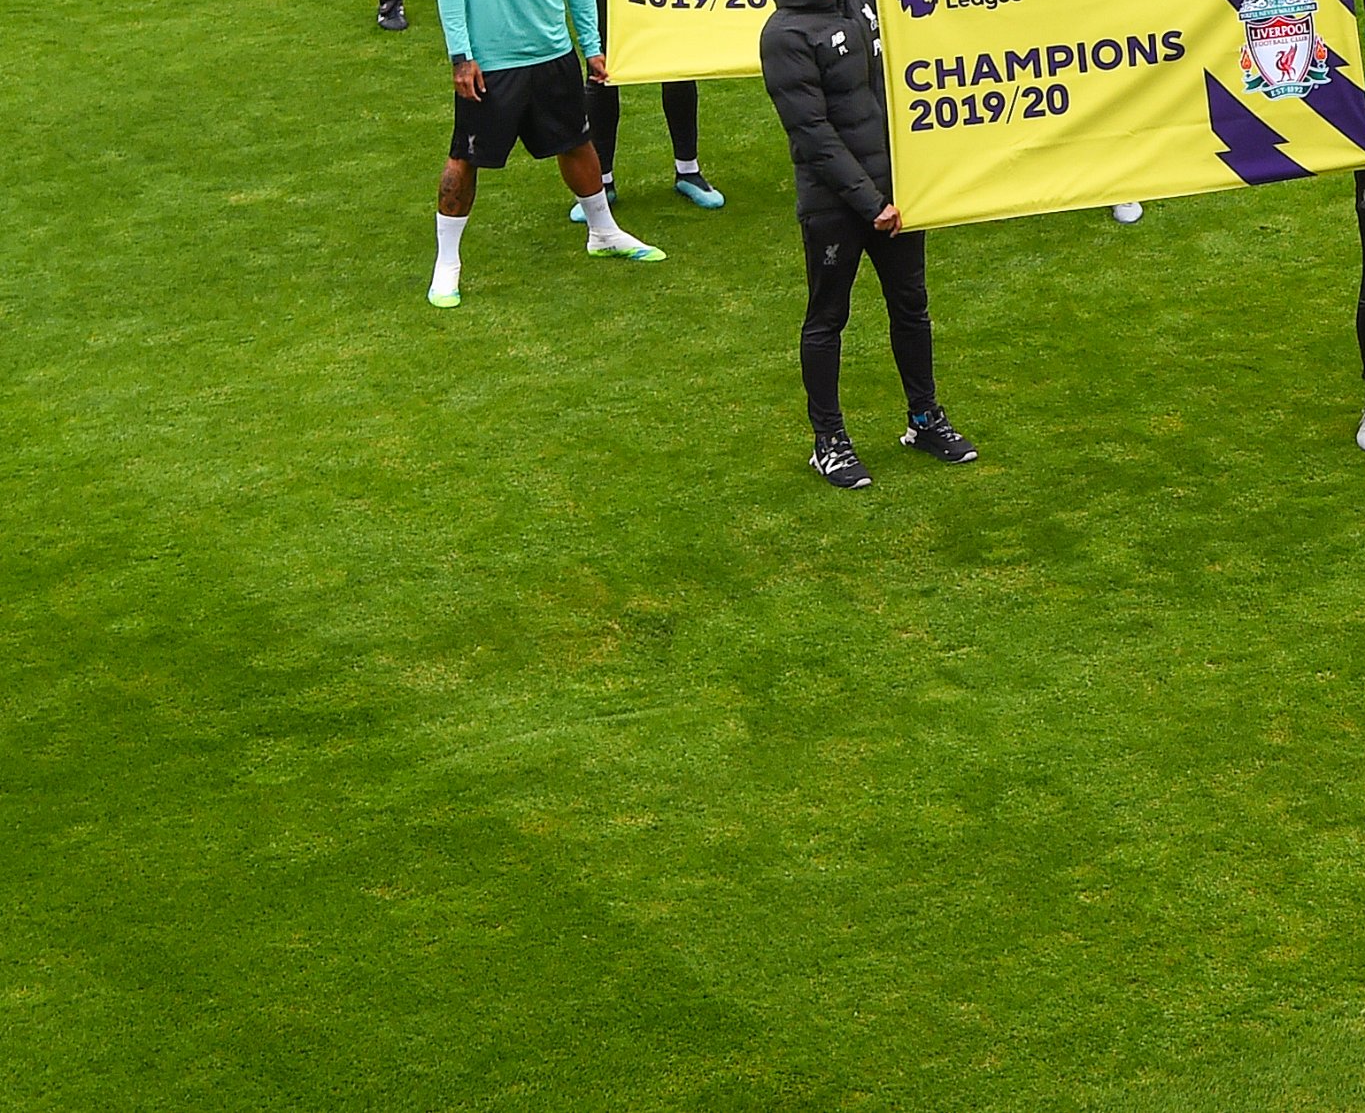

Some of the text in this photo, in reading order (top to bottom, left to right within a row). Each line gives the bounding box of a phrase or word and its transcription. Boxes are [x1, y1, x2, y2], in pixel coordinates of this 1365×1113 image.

[1251, 23, 1309, 39] LIVERPOOL
[905, 31, 1185, 92] CHAMPIONS
[909, 84, 1069, 132] 2019/20
